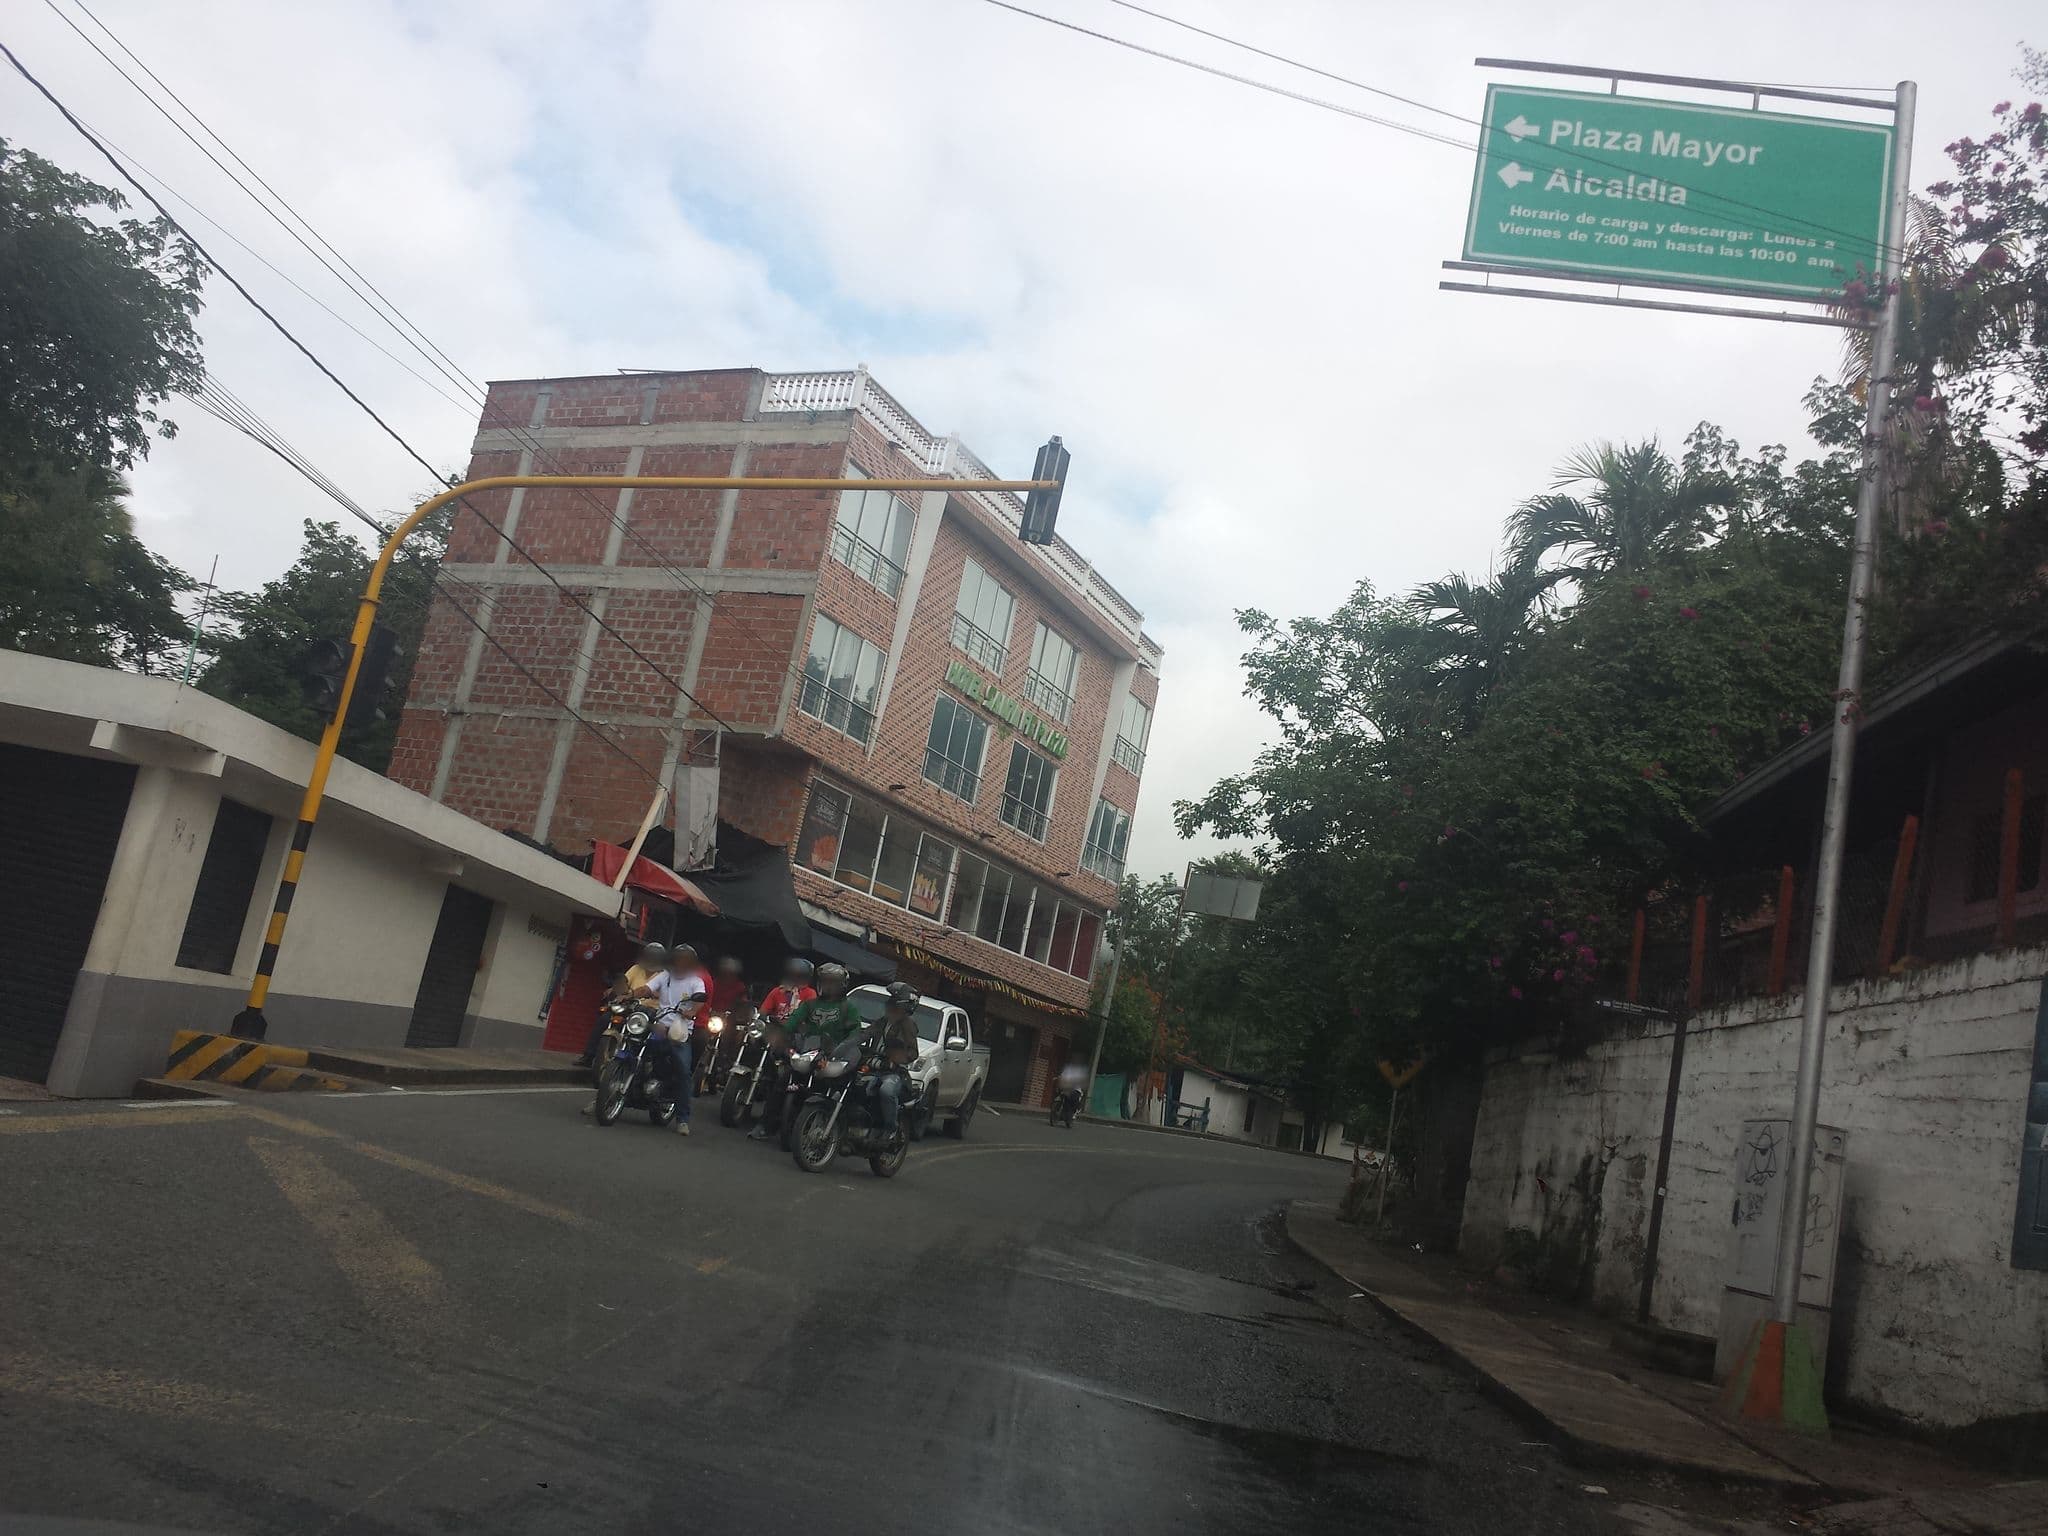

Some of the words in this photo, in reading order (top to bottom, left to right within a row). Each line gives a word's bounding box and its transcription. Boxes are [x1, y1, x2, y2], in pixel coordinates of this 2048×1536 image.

[1550, 119, 1643, 153] Plaza
[1651, 130, 1764, 167] Mayor
[1498, 222, 1562, 239] Viernes
[1568, 230, 1588, 242] de
[1594, 232, 1628, 246] 7:00
[1632, 237, 1657, 249] am
[1665, 239, 1714, 255] hasta
[1719, 245, 1744, 258] las
[1749, 249, 1797, 263] 10:00
[1807, 257, 1834, 268] am
[1509, 204, 1570, 222] Horario
[1575, 212, 1596, 225] de
[1600, 217, 1649, 232] carga
[1655, 222, 1665, 235] y
[1669, 222, 1753, 242] descarga:
[1763, 231, 1817, 248] Lunes
[945, 660, 985, 701] HOTEL
